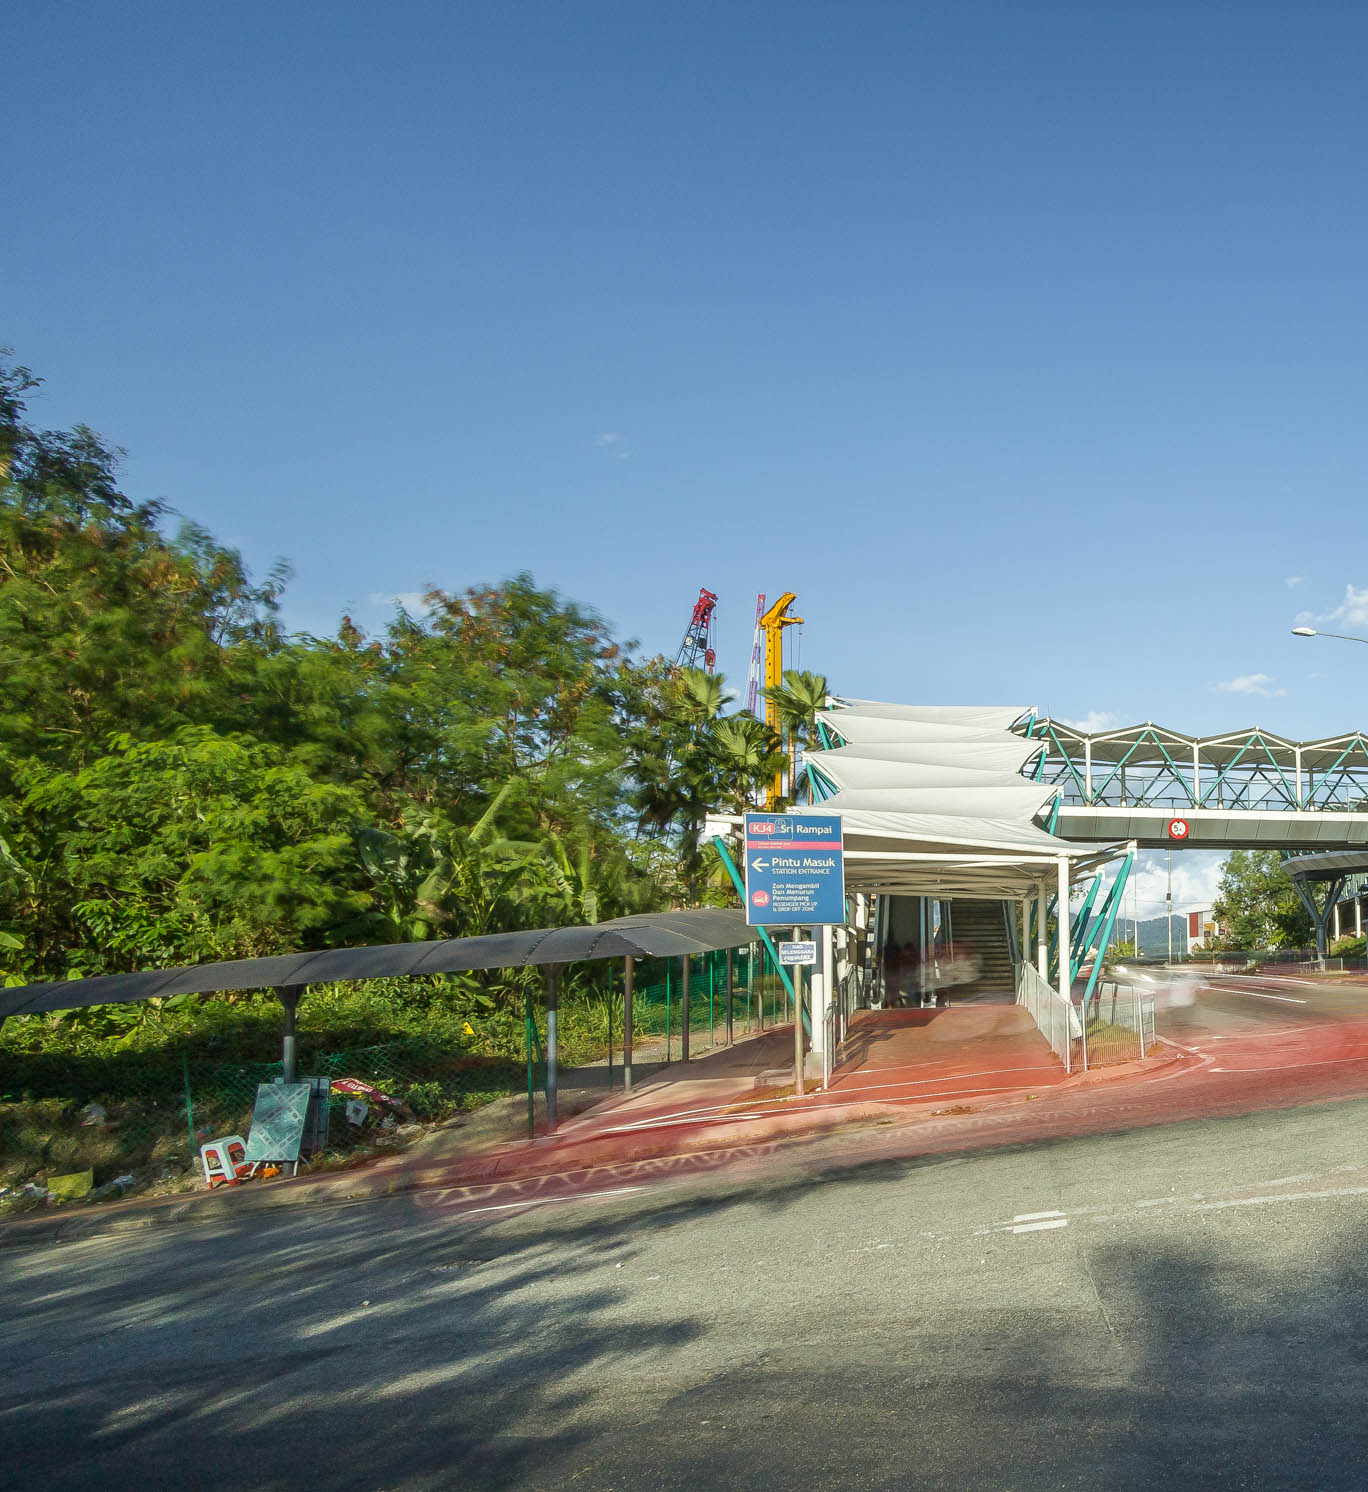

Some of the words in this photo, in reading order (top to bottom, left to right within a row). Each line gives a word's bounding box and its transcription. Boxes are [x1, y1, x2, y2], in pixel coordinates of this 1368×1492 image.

[781, 824, 793, 833] Sri
[796, 824, 832, 836] Rampai
[771, 857, 800, 867] Pintu
[803, 857, 836, 867] Masuk
